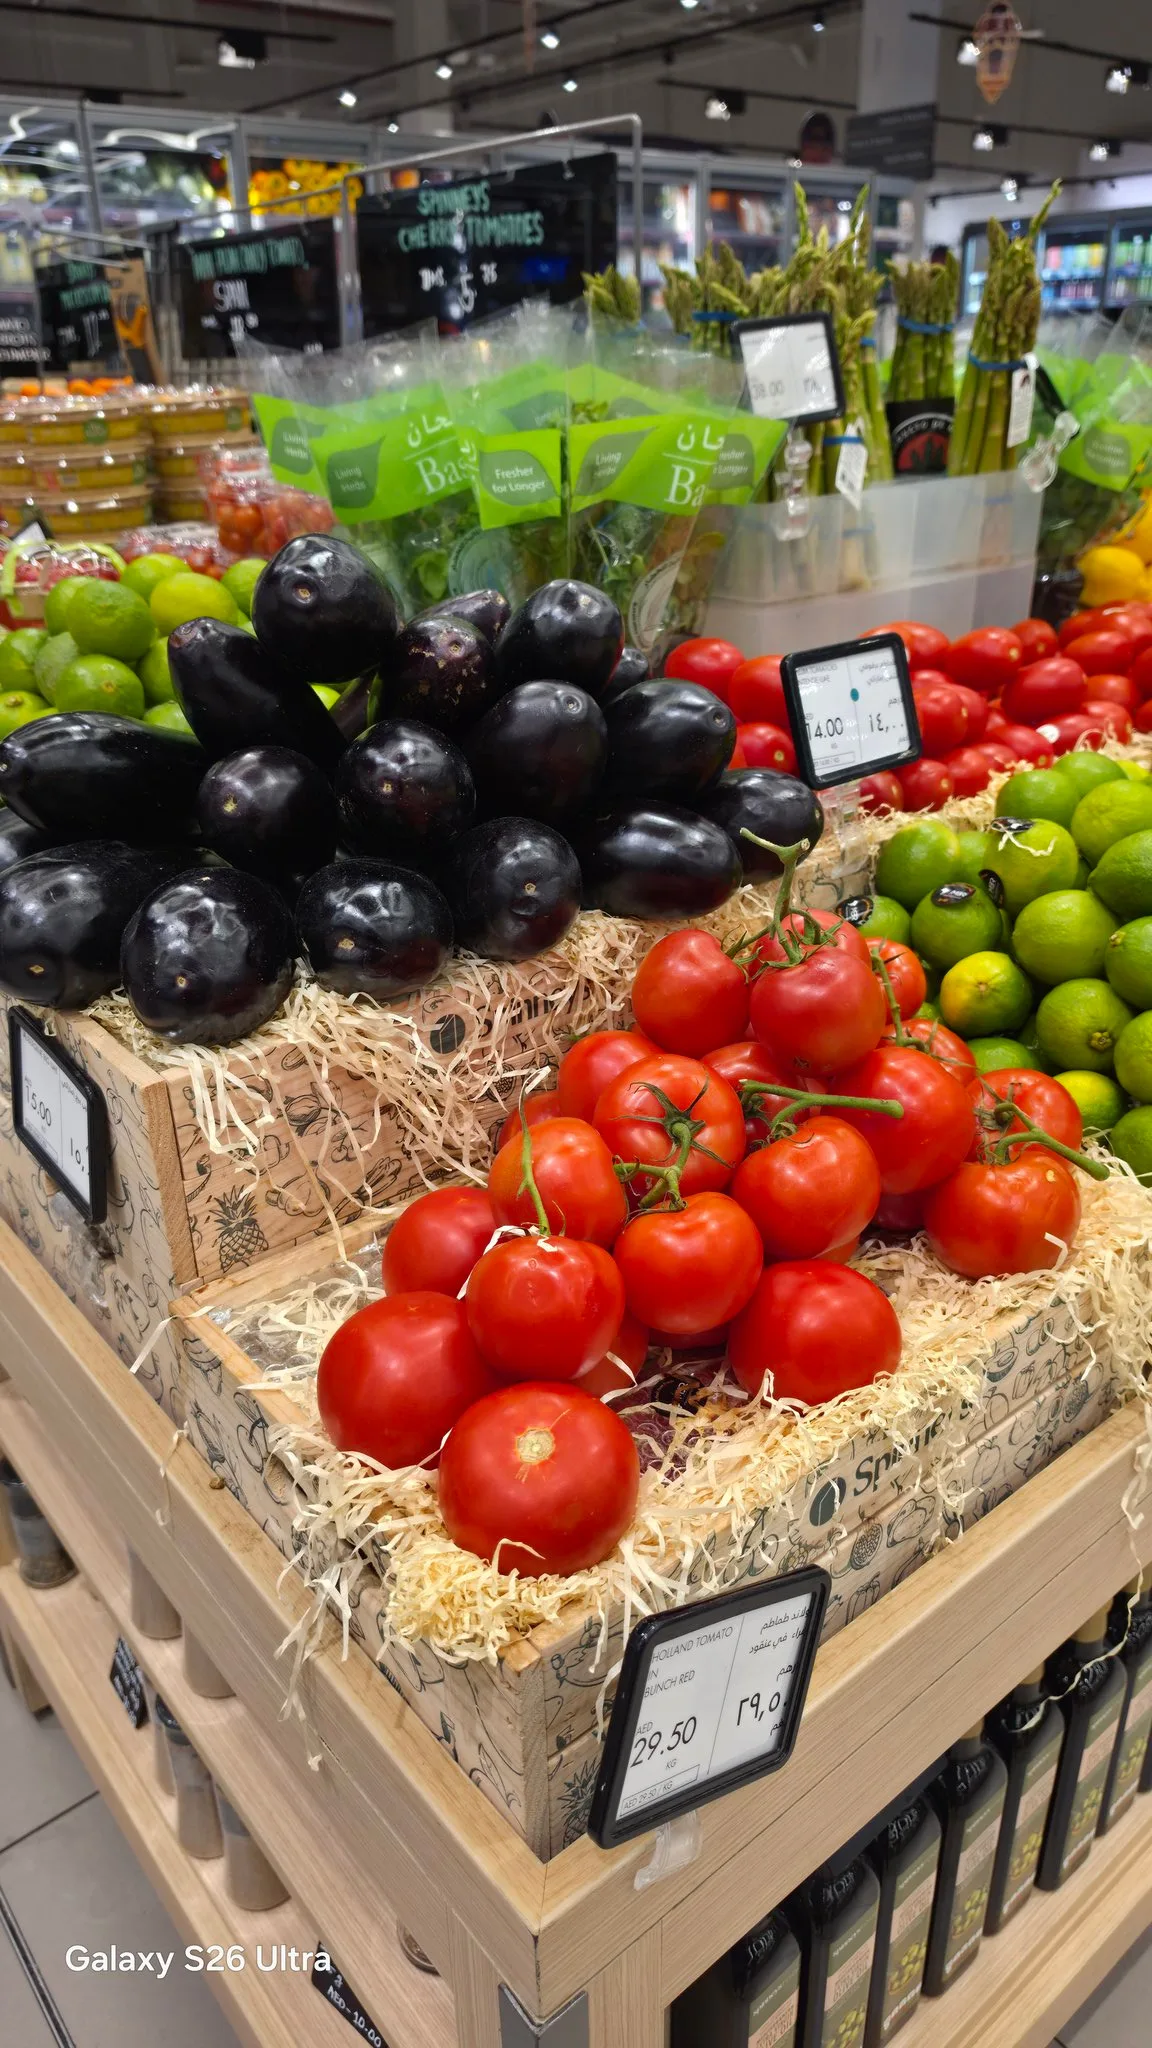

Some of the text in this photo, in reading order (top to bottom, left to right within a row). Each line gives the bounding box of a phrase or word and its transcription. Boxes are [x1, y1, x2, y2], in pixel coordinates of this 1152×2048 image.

[417, 180, 491, 216] SPINNEYS
[464, 211, 545, 247] TOMATOES
[495, 465, 534, 480] Fresher
[491, 479, 546, 495] for Longer
[805, 716, 844, 741] 14.00
[25, 1084, 52, 1127] 15.00
[760, 1612, 790, 1635] طماطم
[651, 1626, 733, 1664] HOLLAND TOMATO
[772, 1634, 788, 1651] في
[643, 1669, 696, 1699] BUNCH RED
[636, 1721, 654, 1736] AED
[629, 1716, 698, 1769] 29.50
[665, 1758, 677, 1770] KG
